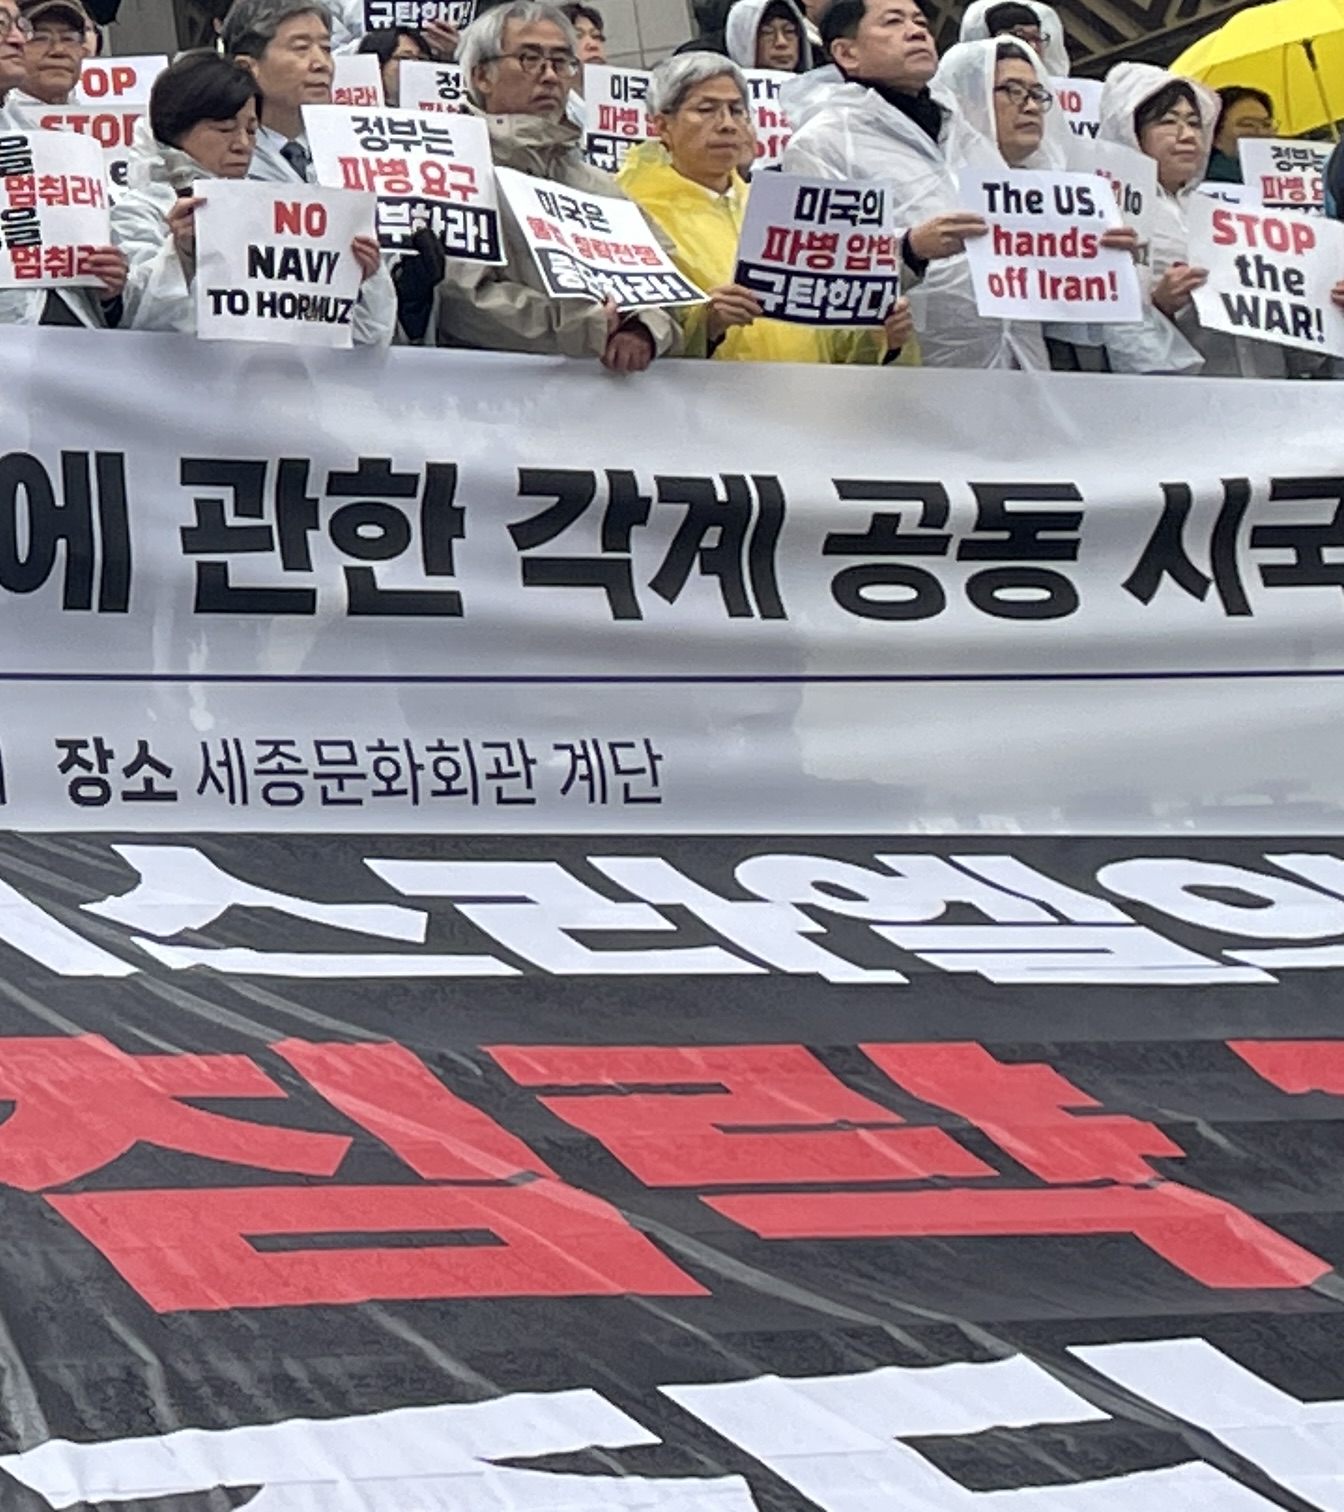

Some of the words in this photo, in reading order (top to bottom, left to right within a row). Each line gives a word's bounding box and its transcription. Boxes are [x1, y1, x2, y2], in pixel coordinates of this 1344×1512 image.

[81, 67, 137, 97] OP
[350, 116, 455, 157] 정부는
[598, 104, 639, 136] 파병
[337, 156, 414, 193] 파병
[419, 160, 479, 202] 요구
[982, 181, 1044, 216] The
[1260, 175, 1306, 201] 파병
[273, 200, 328, 237] NO
[535, 188, 612, 234] 미국은
[794, 186, 885, 227] 미국의
[377, 201, 491, 254] 부하라!
[761, 226, 840, 270] 파병
[992, 226, 1098, 259] hands
[1211, 209, 1317, 256] STOP
[247, 244, 341, 286] NAVY
[987, 266, 1029, 299] off
[1039, 269, 1118, 301] Iran!
[1234, 254, 1305, 297] the
[207, 288, 250, 317] TO
[1219, 292, 1325, 343] WAR!
[179, 457, 466, 618] 관한
[506, 467, 789, 622] 각계
[822, 478, 1085, 622] 공동
[55, 736, 179, 808] 장소
[195, 737, 538, 808] 세종문화회관
[559, 737, 664, 806] 계단
